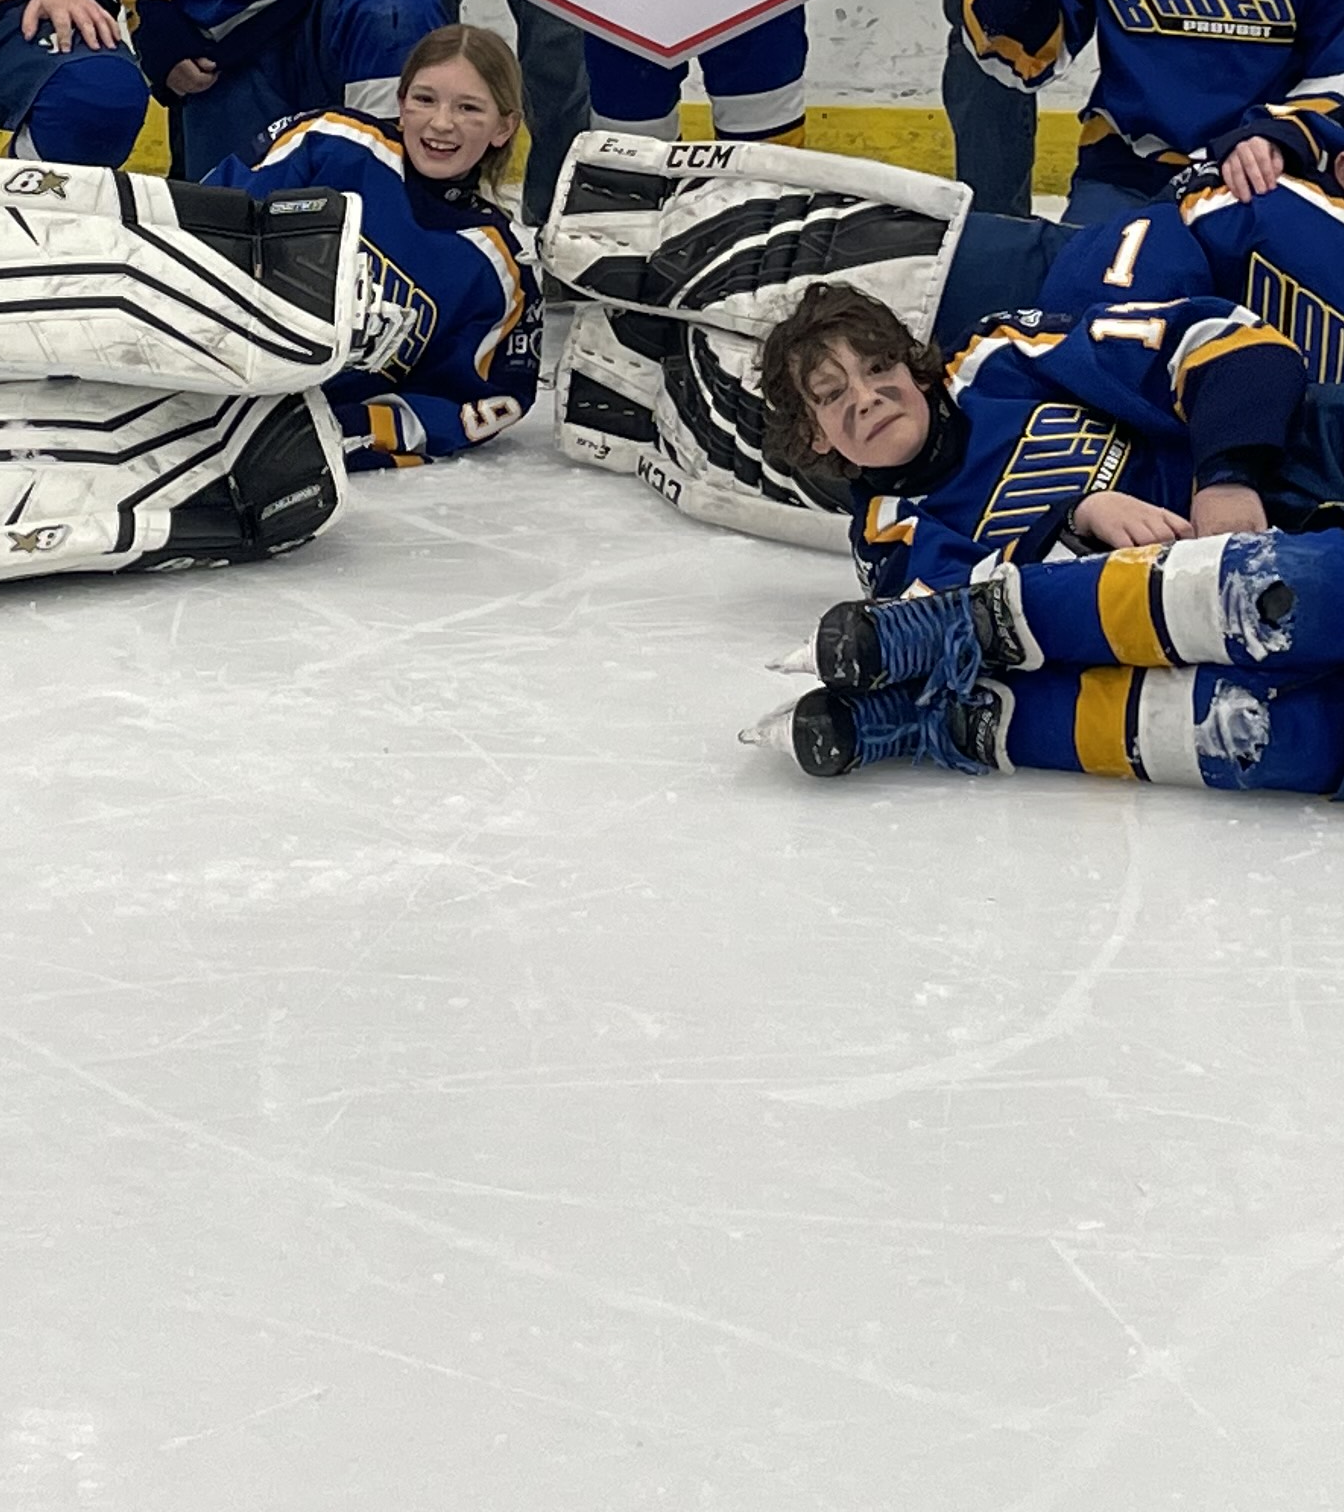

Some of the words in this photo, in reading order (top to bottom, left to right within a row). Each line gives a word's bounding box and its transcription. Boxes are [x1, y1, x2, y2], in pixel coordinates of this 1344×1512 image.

[1182, 19, 1273, 39] PROVOST
[666, 145, 736, 170] CCM
[637, 455, 683, 508] CCM
